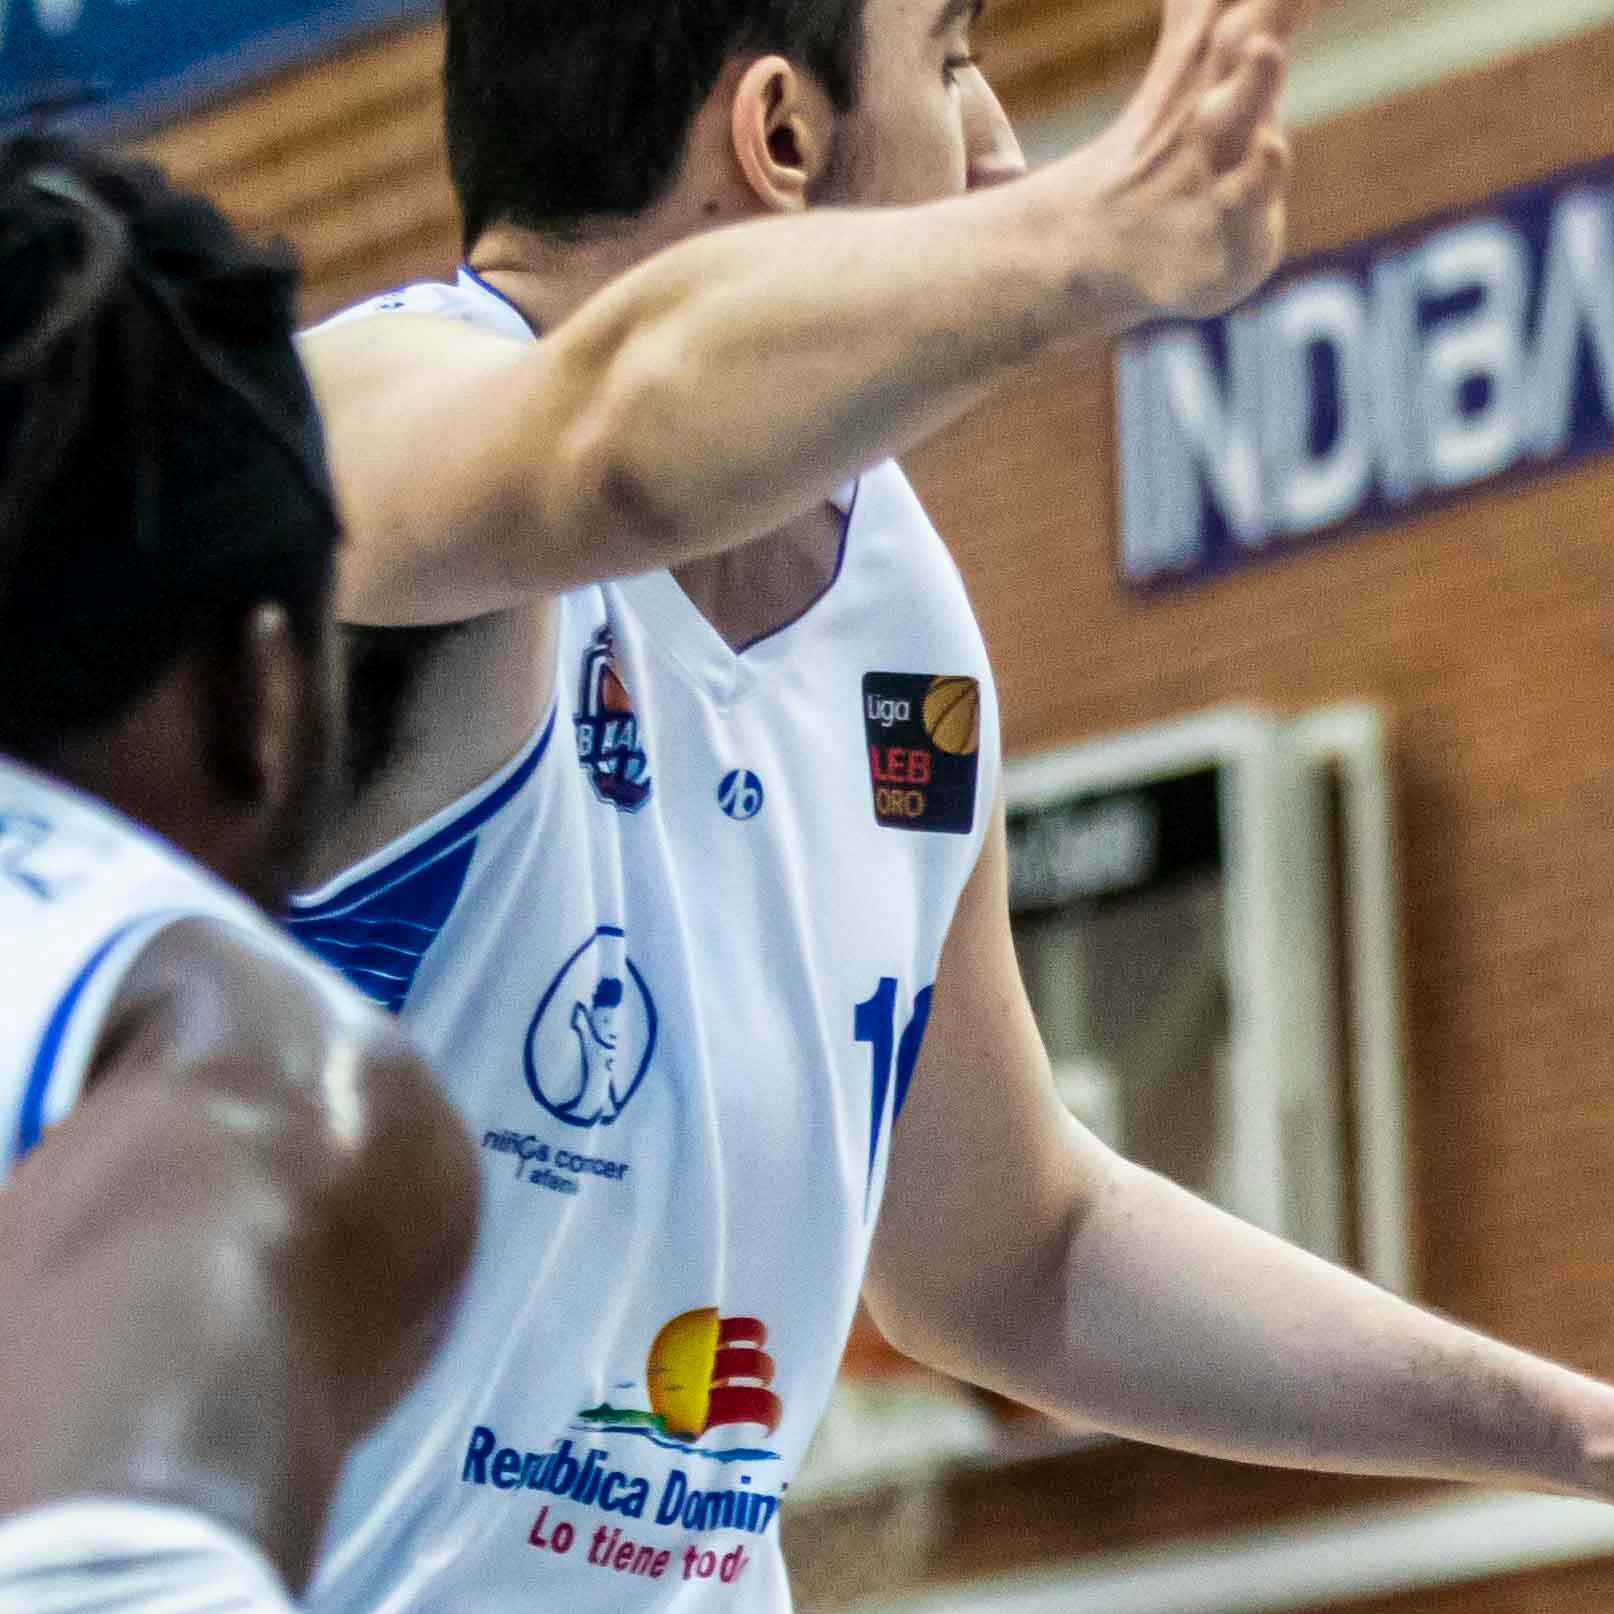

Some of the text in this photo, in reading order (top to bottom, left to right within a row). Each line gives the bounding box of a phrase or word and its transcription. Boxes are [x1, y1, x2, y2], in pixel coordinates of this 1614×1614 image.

[870, 745, 931, 784] LEB
[876, 787, 925, 818] ORO
[527, 1505, 576, 1554] Lo
[586, 1524, 672, 1580] tiene
